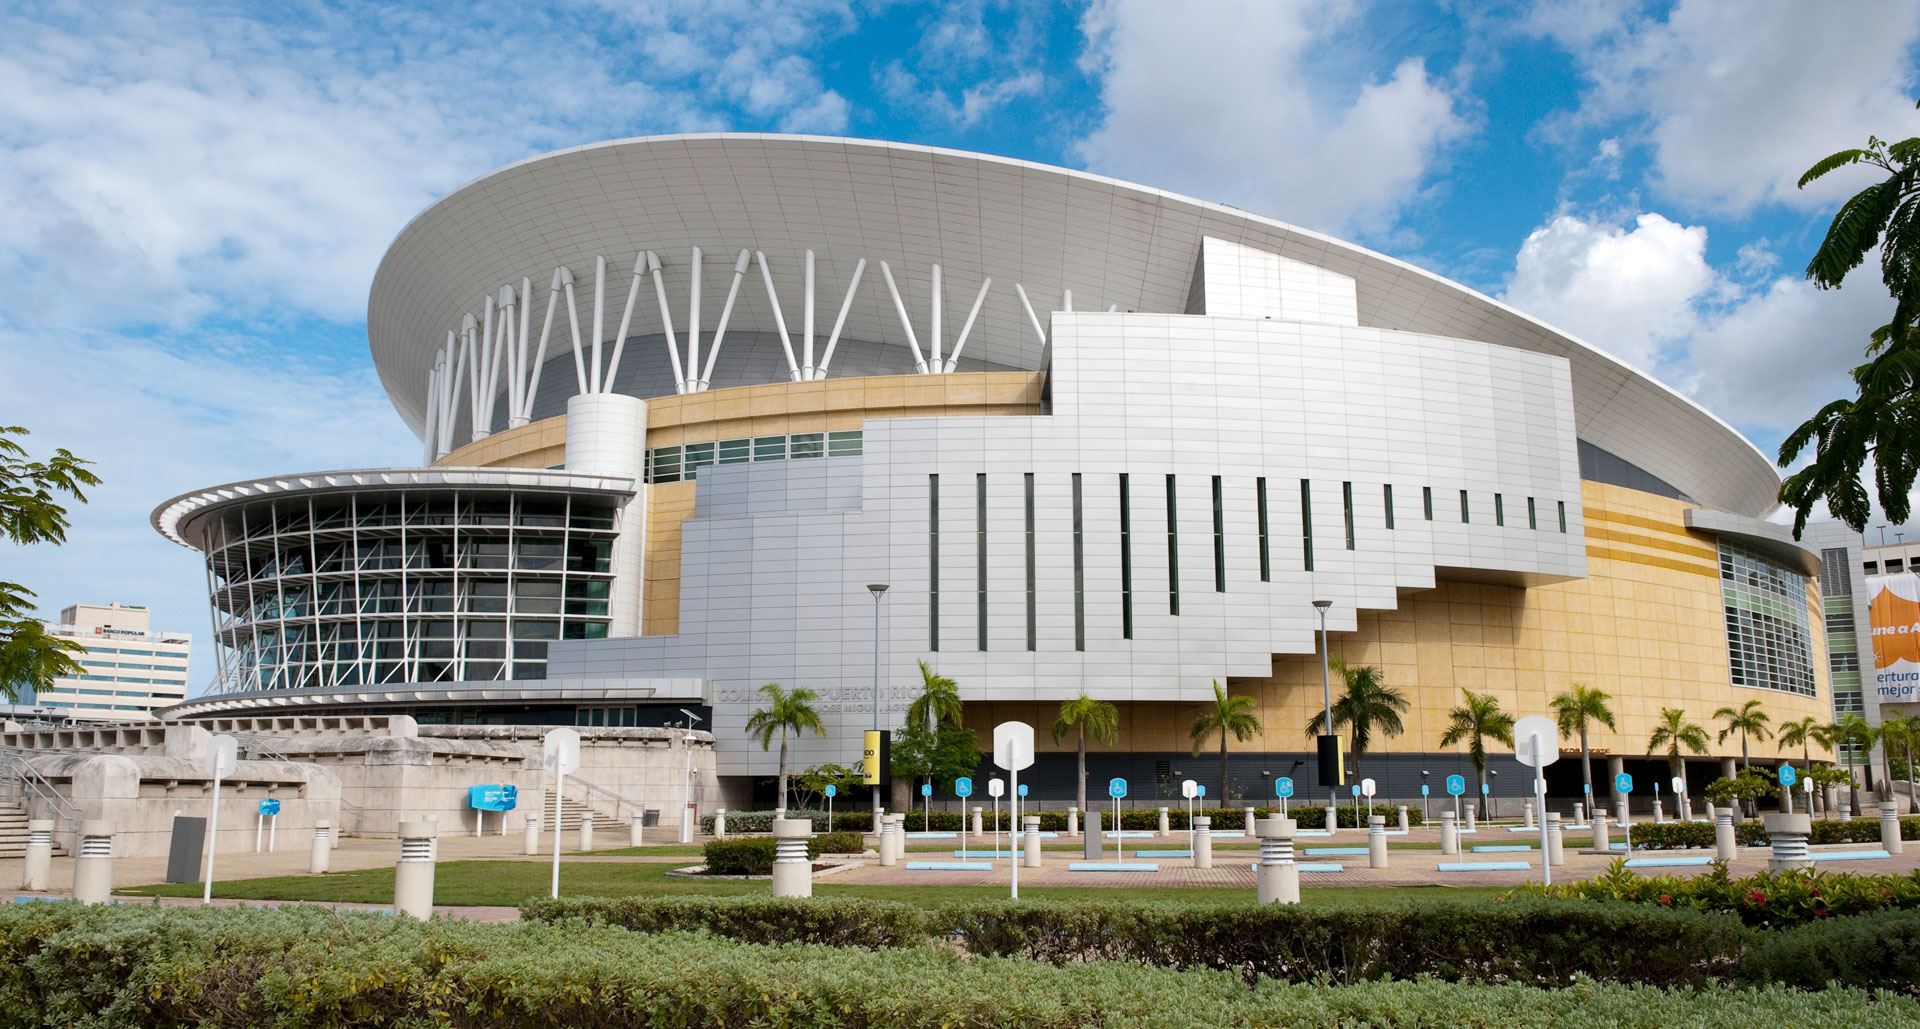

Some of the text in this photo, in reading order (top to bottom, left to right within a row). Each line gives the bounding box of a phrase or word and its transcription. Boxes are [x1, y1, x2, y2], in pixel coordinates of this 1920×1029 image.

[1897, 624, 1908, 634] a
[818, 686, 885, 701] PUERTO
[1877, 684, 1915, 698] mejor
